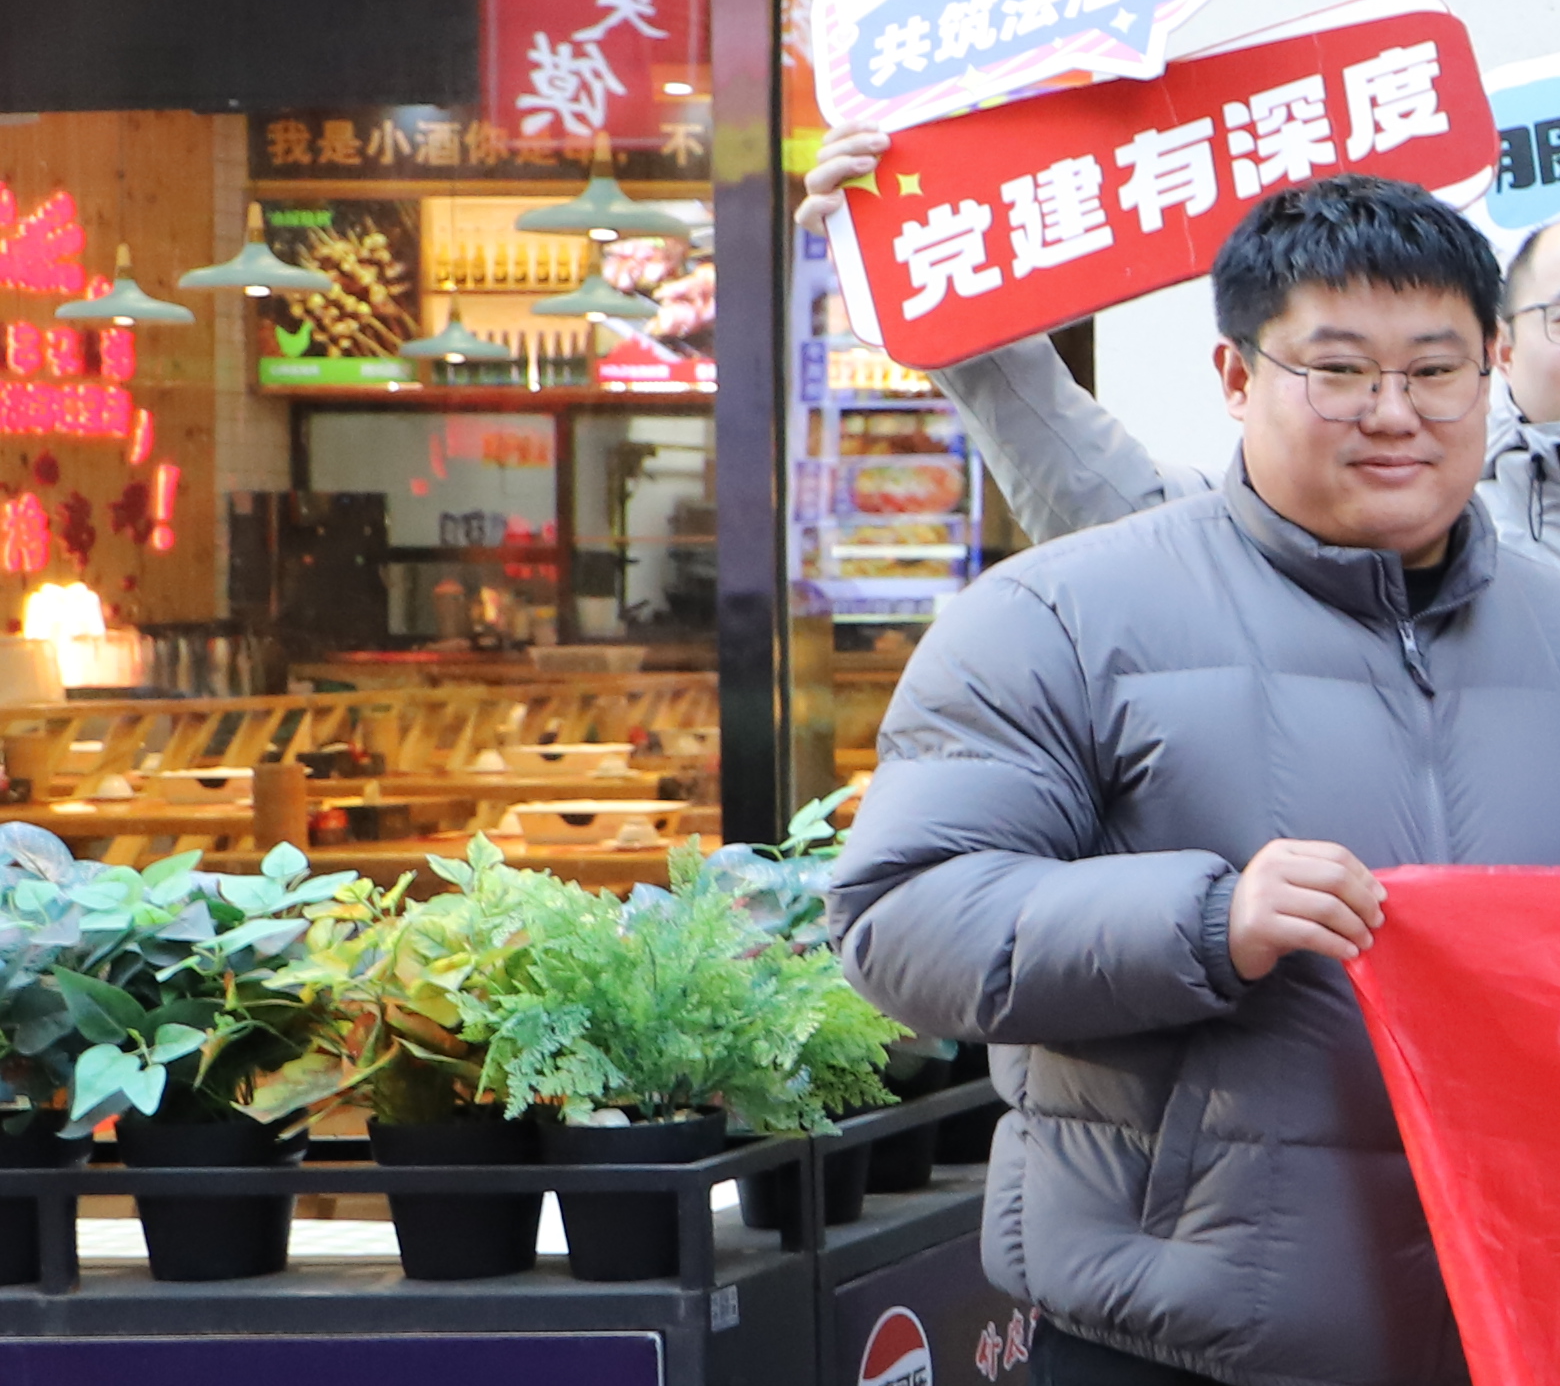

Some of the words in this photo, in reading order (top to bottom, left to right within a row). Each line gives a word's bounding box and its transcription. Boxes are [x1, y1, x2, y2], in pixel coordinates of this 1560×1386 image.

[893, 40, 1449, 321] 党建有深度
